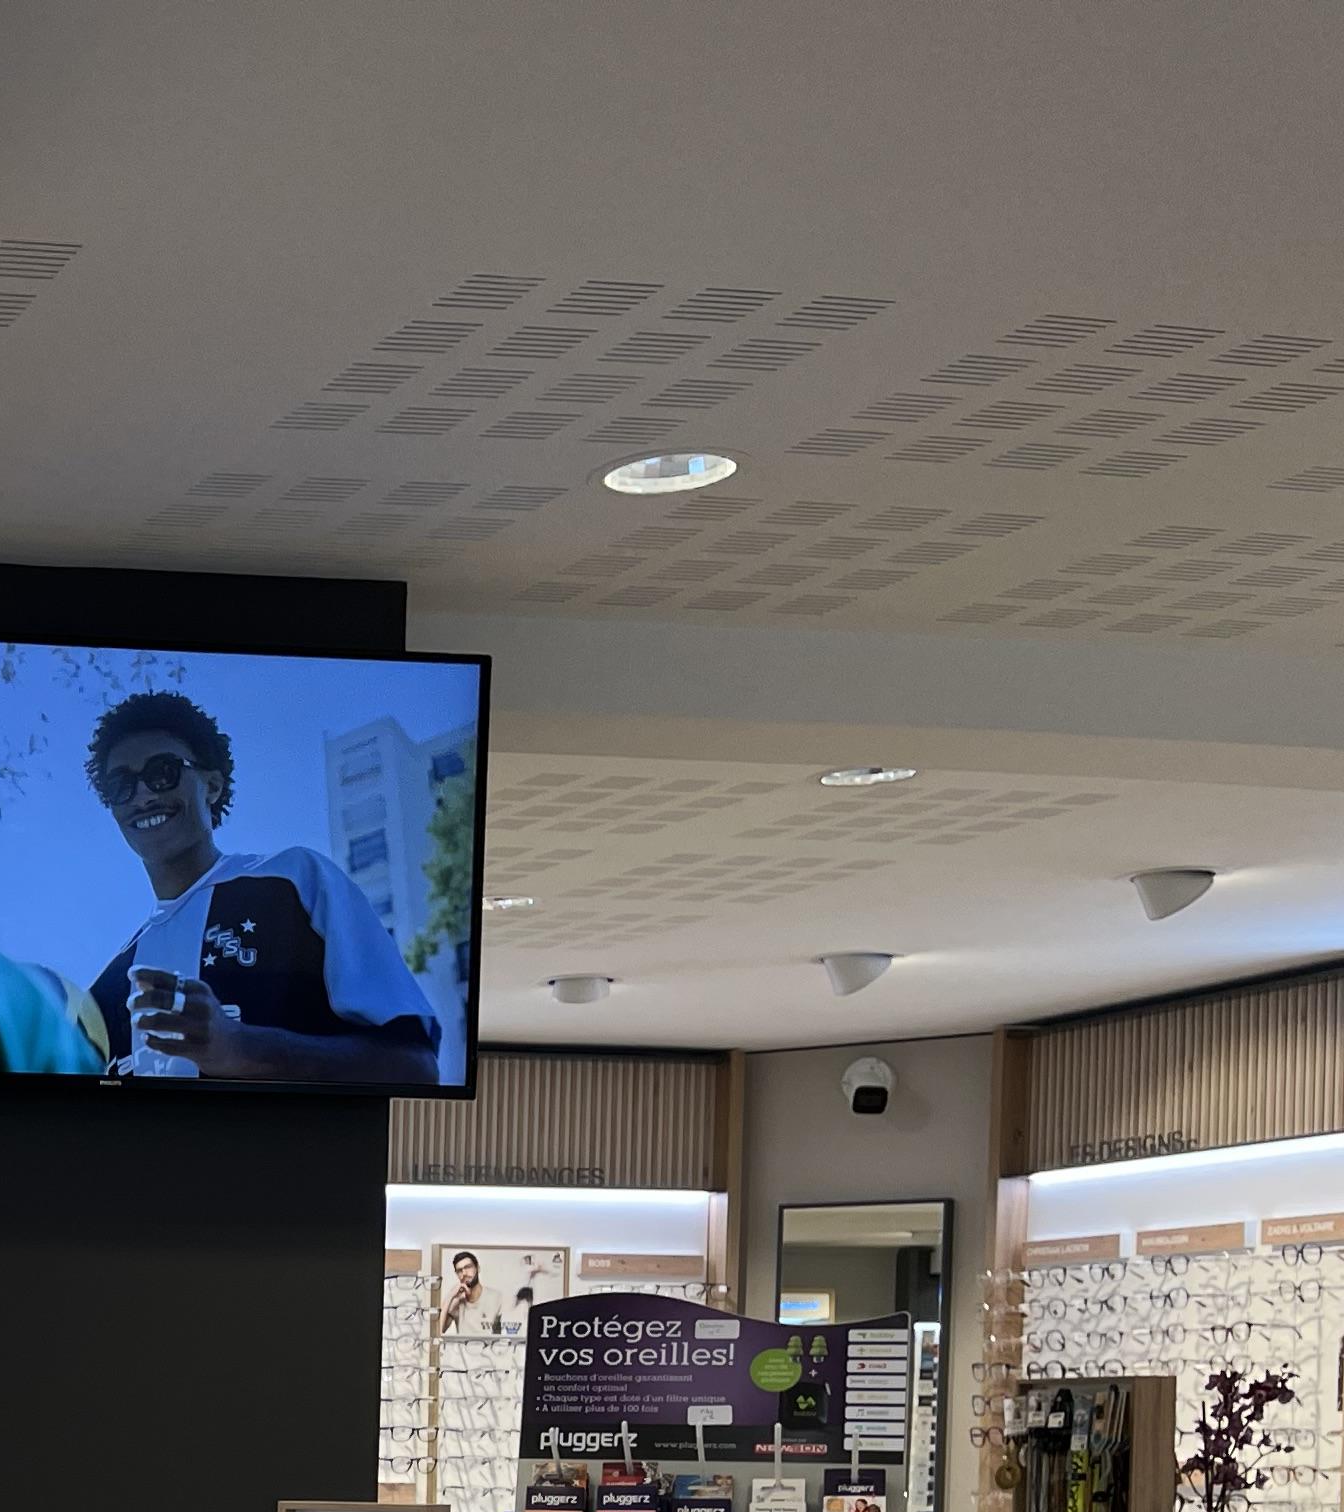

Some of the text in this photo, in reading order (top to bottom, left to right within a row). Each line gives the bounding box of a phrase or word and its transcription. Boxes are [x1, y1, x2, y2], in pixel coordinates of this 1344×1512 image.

[204, 923, 257, 967] CFSU
[540, 1314, 683, 1343] Protégez
[539, 1342, 735, 1367] vos oreilles!
[543, 1373, 588, 1383] Bouchons
[557, 1383, 590, 1392] confort
[592, 1383, 628, 1393] optimal
[542, 1394, 578, 1404] Chaque
[580, 1395, 602, 1404] type
[585, 1405, 605, 1414] plus
[623, 1405, 640, 1413] 100
[641, 1405, 659, 1413] fois
[531, 1494, 578, 1506] pluggerz
[602, 1493, 650, 1505] pluggerz
